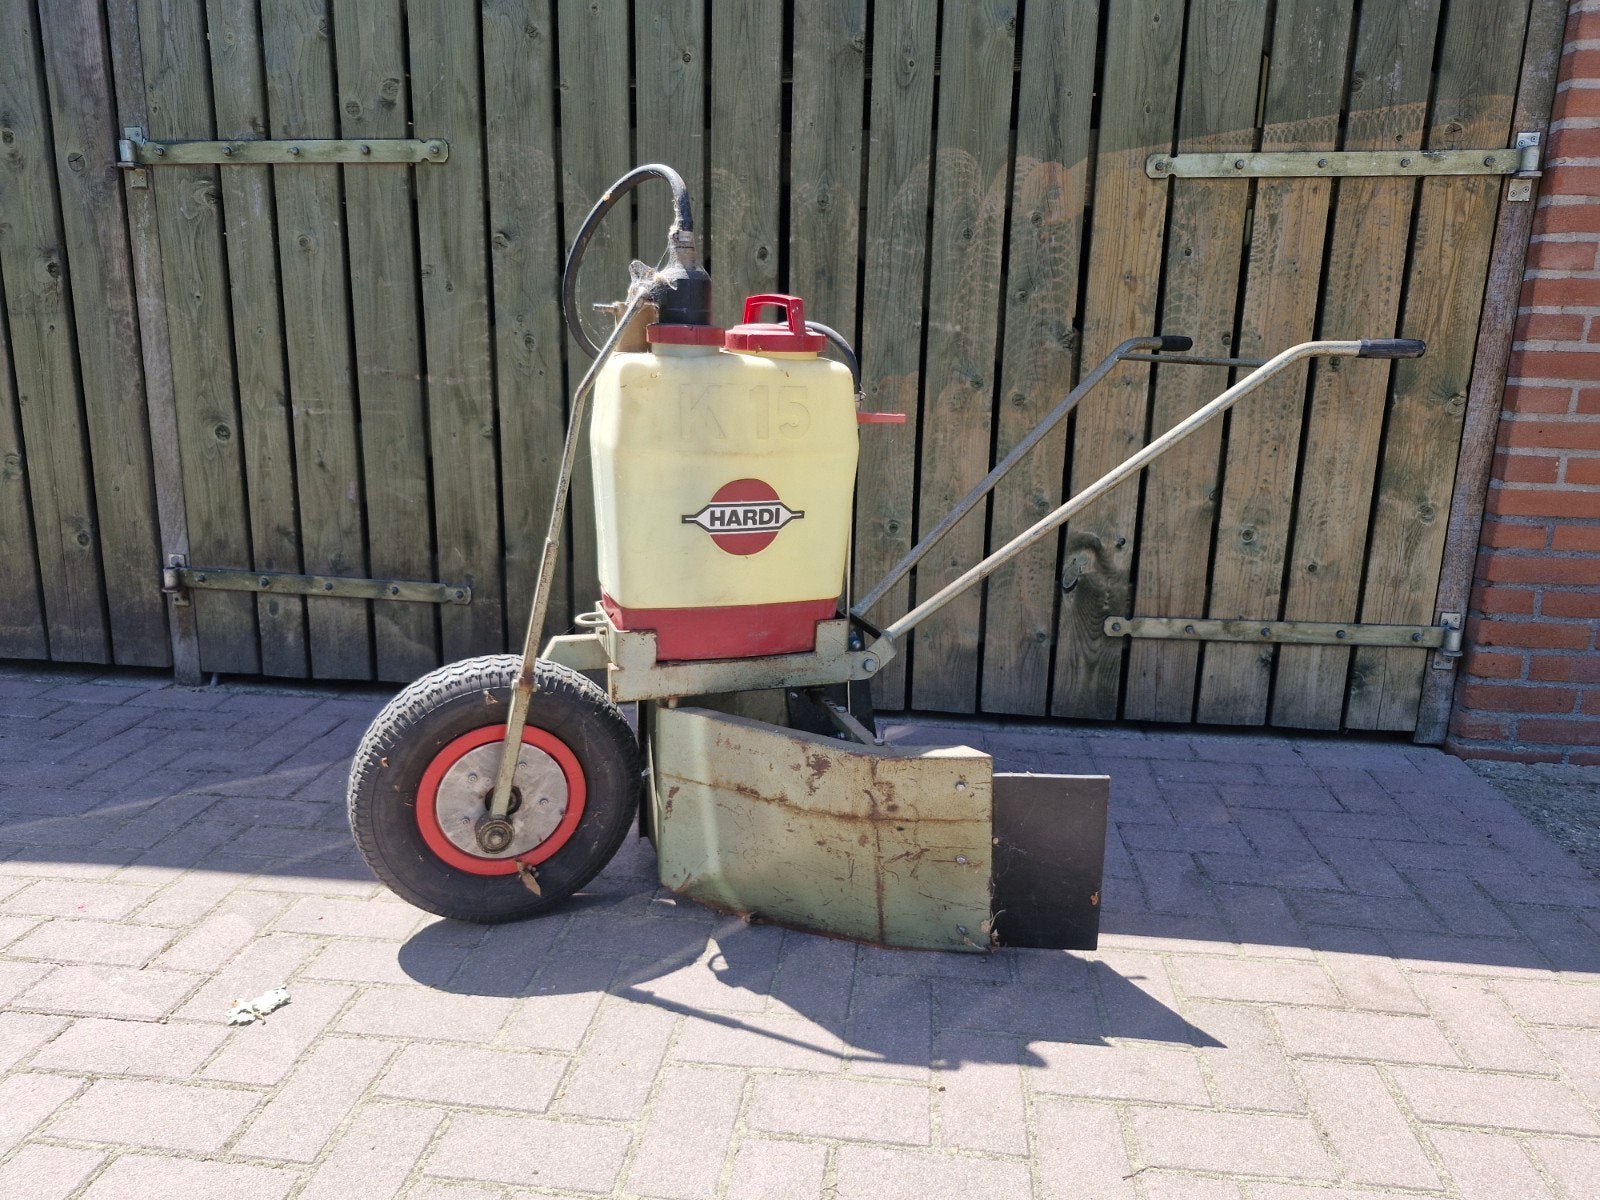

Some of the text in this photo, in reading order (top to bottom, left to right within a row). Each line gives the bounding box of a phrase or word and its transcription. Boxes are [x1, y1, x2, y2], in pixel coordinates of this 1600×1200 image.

[679, 383, 811, 440] K 15
[709, 507, 781, 527] HARDI
